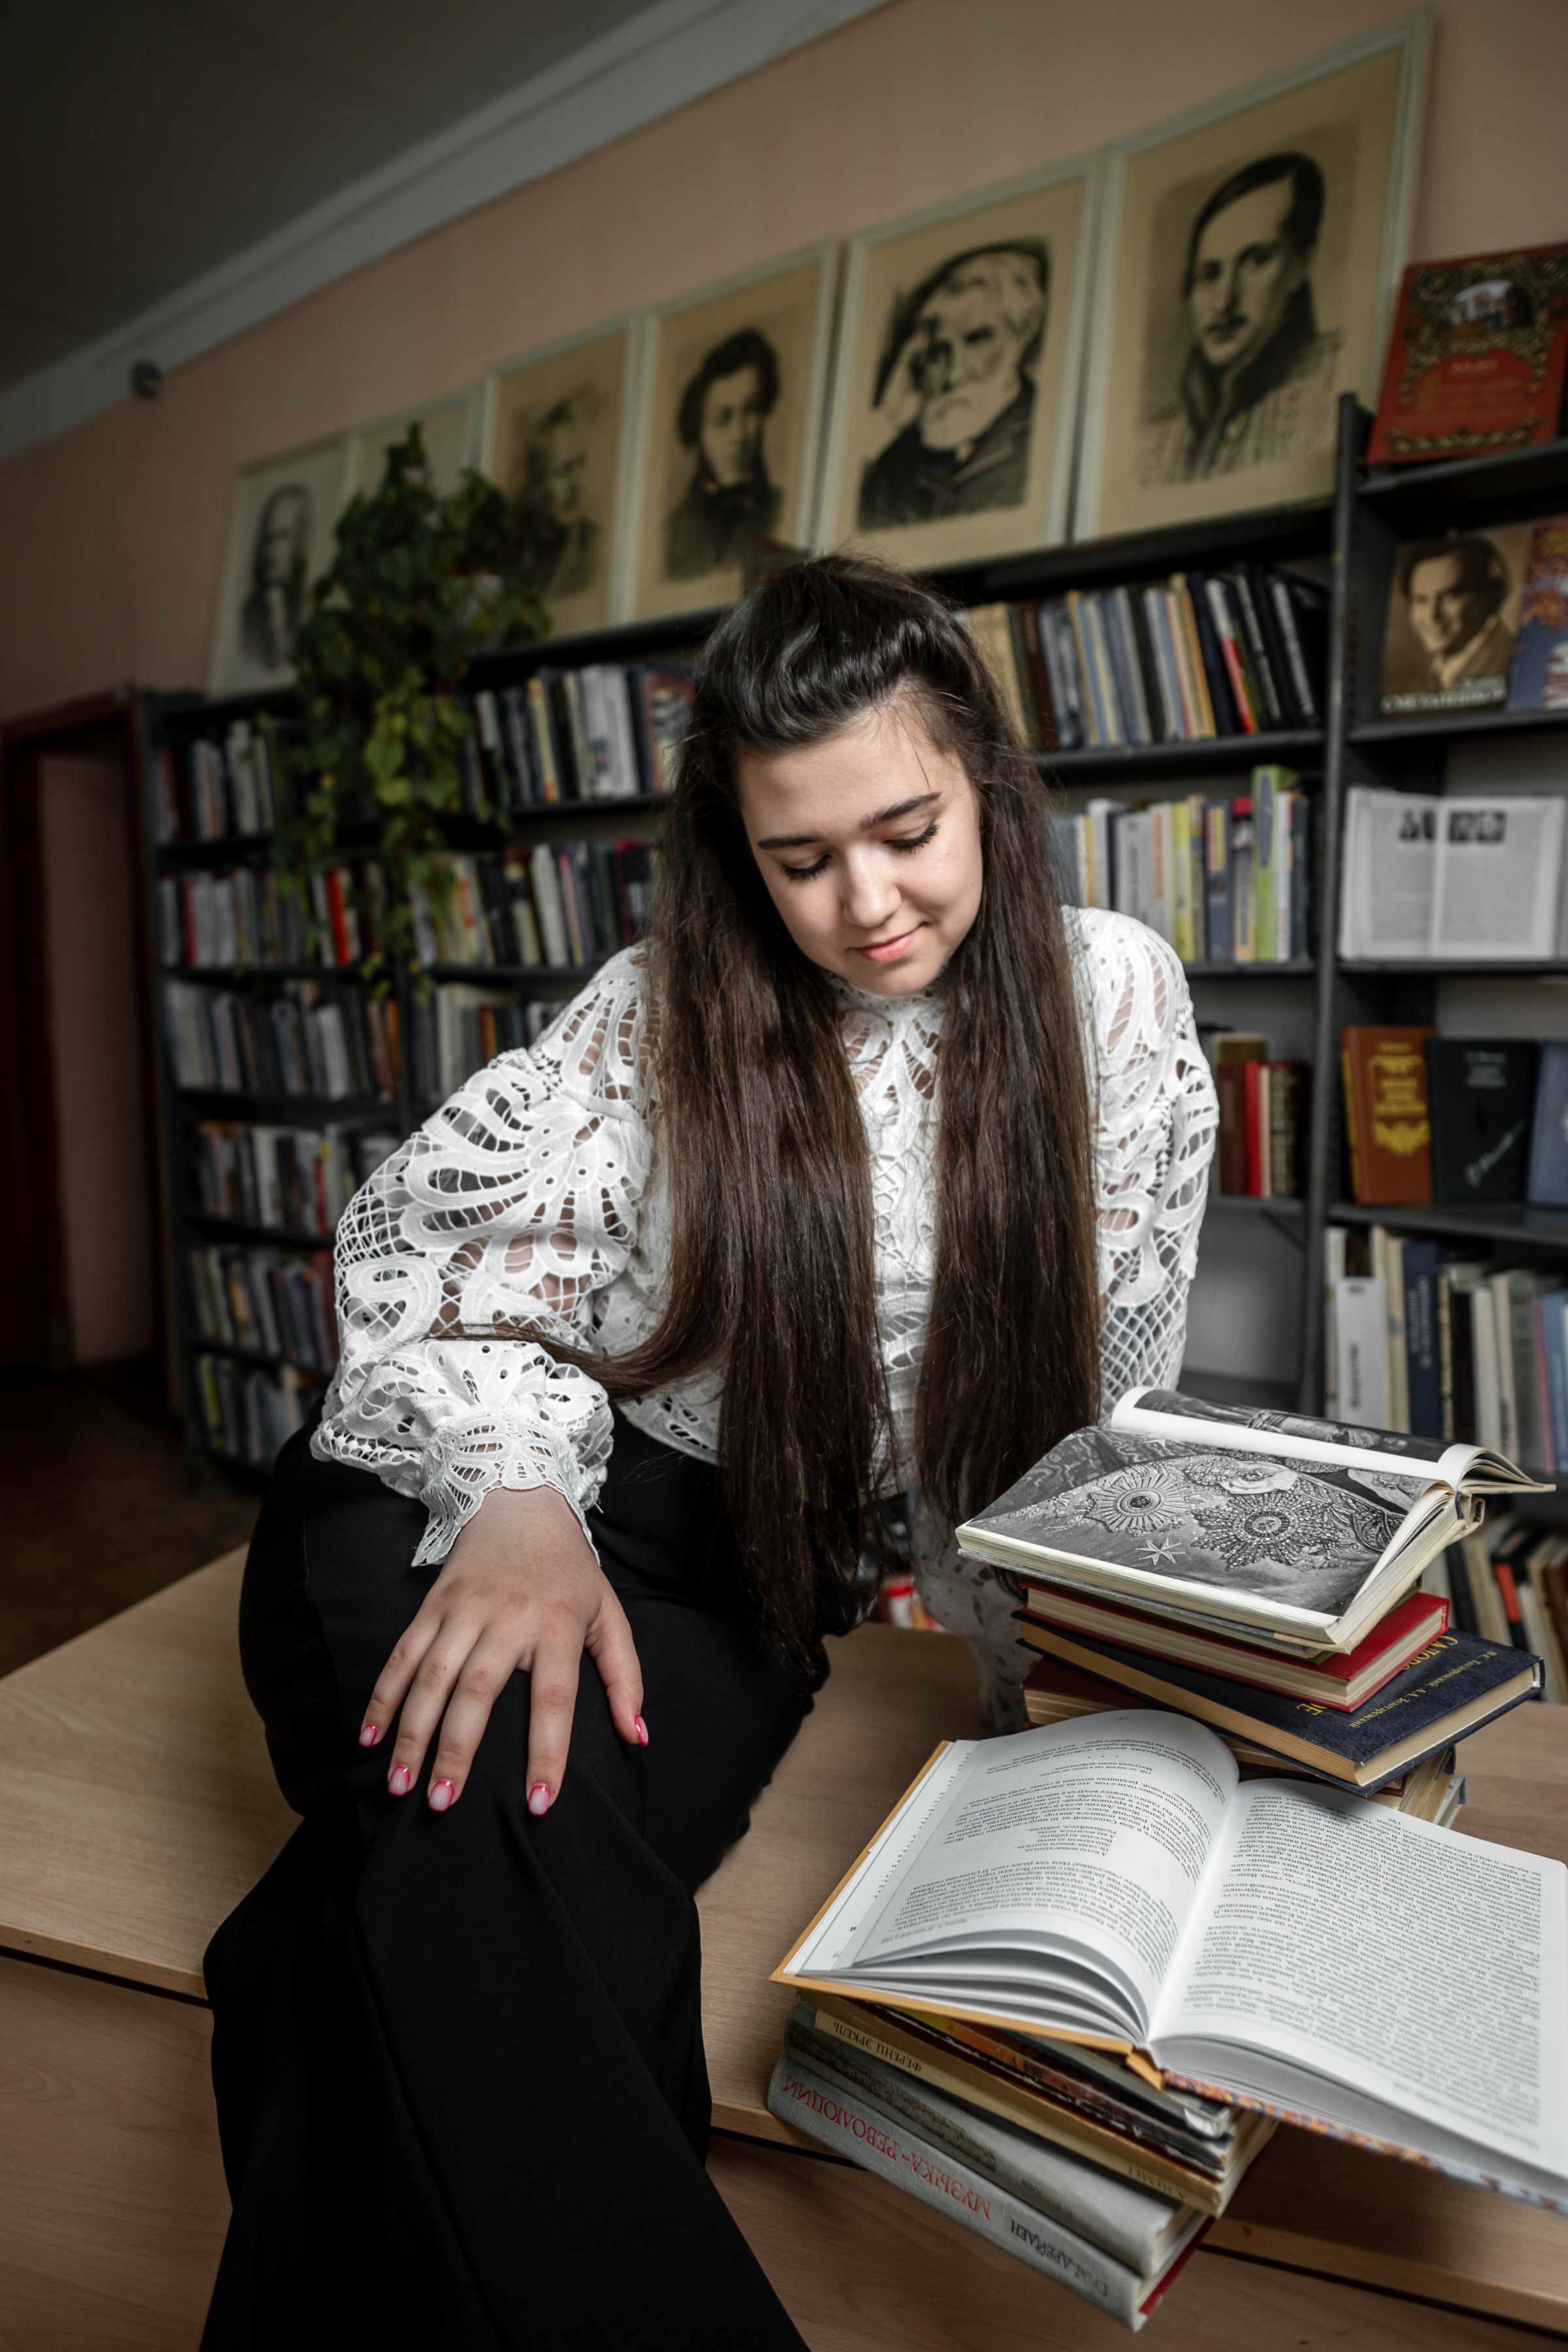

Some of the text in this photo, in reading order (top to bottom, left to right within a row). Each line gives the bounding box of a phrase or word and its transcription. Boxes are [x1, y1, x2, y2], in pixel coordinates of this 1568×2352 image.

[833, 2021, 922, 2072] ФЕРЕНЦ ЭРКЕЛЬ
[1010, 2219, 1075, 2269] ДРЕЙДЕН
